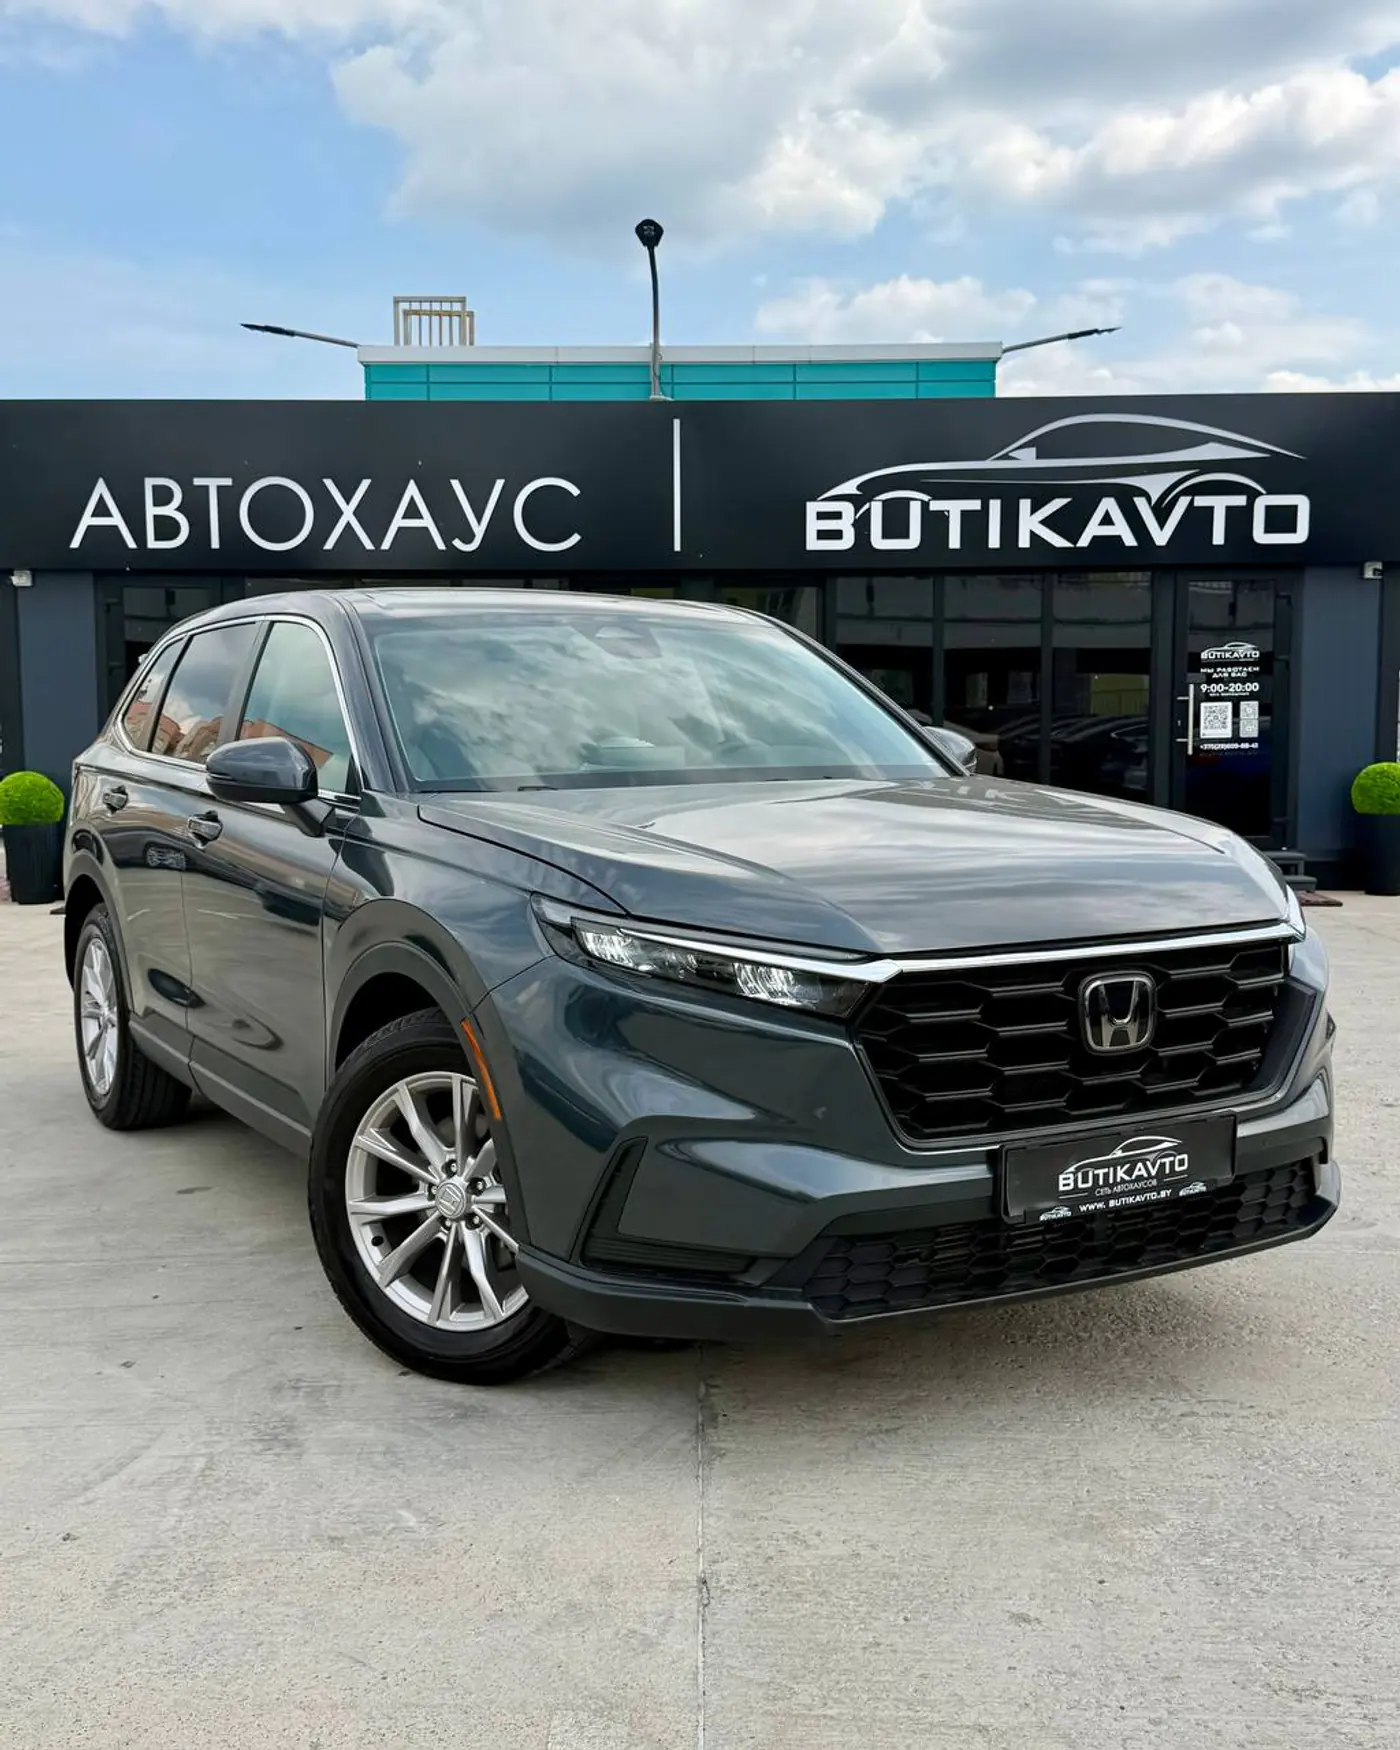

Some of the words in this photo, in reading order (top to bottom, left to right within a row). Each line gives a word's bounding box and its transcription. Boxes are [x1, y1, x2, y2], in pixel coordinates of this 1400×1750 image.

[70, 476, 582, 553] АВТОХАУС
[805, 493, 1311, 552] BUTIKAVTO
[1200, 682, 1260, 693] 9:00-20:00
[1058, 1153, 1189, 1192] BUTIKAVTO
